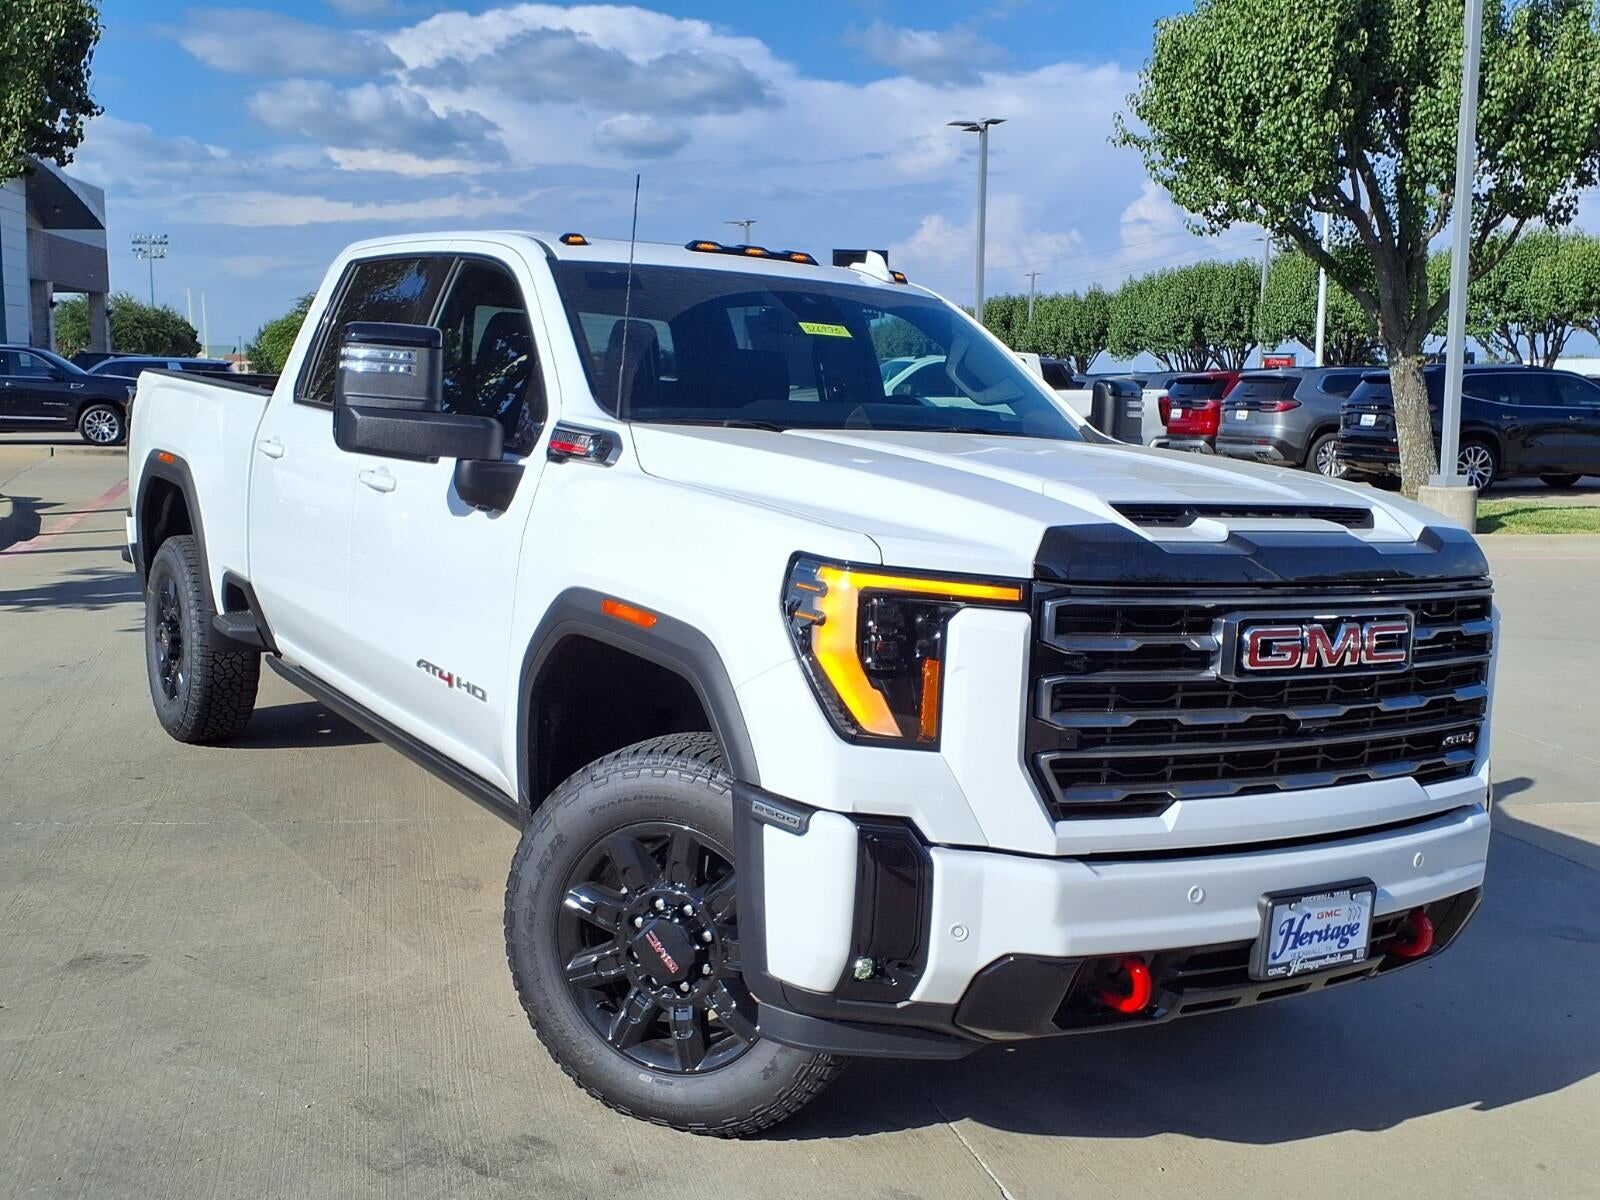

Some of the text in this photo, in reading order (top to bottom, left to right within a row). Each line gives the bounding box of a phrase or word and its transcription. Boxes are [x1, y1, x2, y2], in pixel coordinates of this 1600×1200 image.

[1242, 620, 1409, 671] GMC
[753, 803, 798, 825] 2500
[1271, 912, 1361, 960] Heritage
[1316, 908, 1342, 920] GMC
[644, 929, 679, 974] GMC
